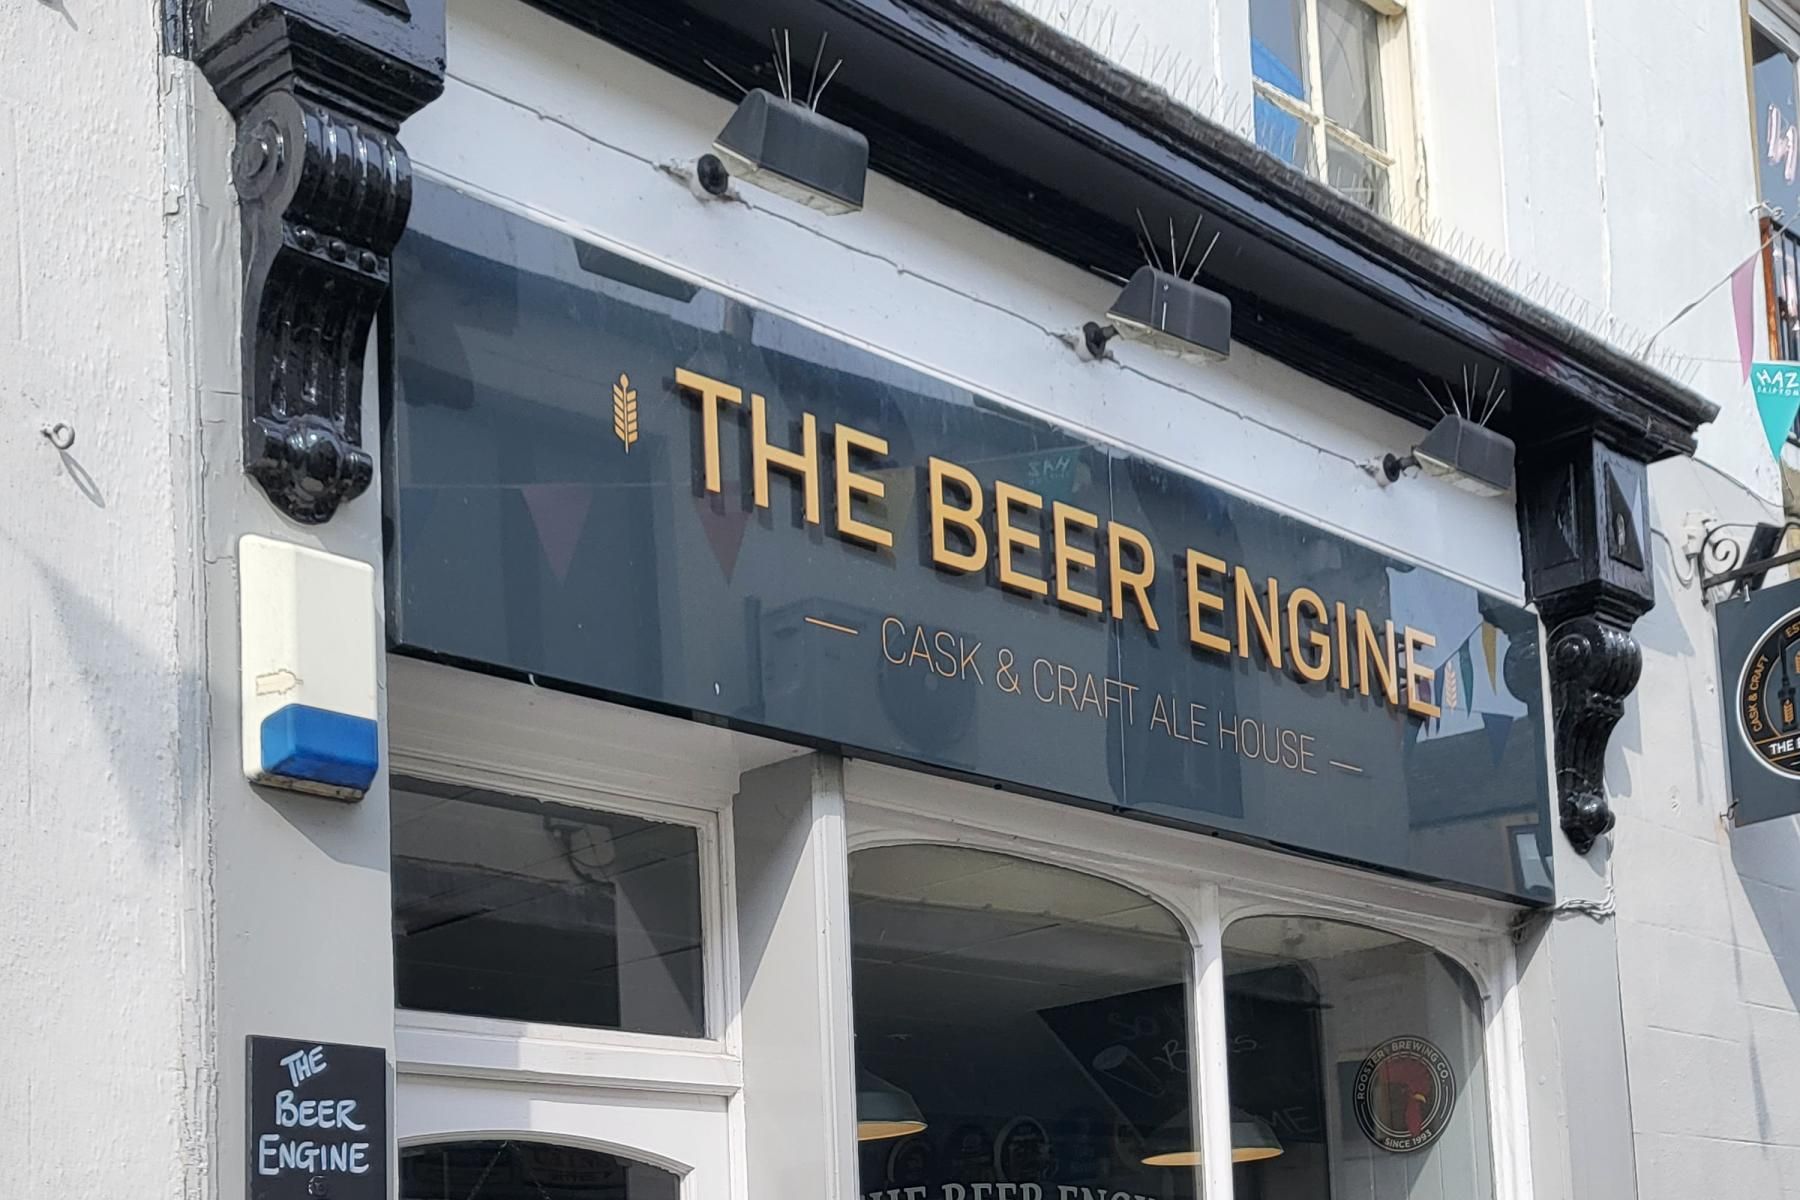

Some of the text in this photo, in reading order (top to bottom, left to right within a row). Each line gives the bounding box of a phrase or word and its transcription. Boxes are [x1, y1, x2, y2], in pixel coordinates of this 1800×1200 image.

[675, 367, 1441, 718] THE BEER ENGINE
[881, 617, 1318, 775] CASK & CRAFT ALE HOUSE
[1748, 653, 1769, 733] CASK & CRAFT
[1768, 738, 1794, 755] THE
[280, 1045, 328, 1088] THE
[1356, 1047, 1392, 1100] ROOSTER
[1391, 1040, 1438, 1062] BREWING
[275, 1090, 366, 1131] BEER
[258, 1134, 370, 1175] ENGINE
[1384, 1129, 1432, 1148] SINCE 1993
